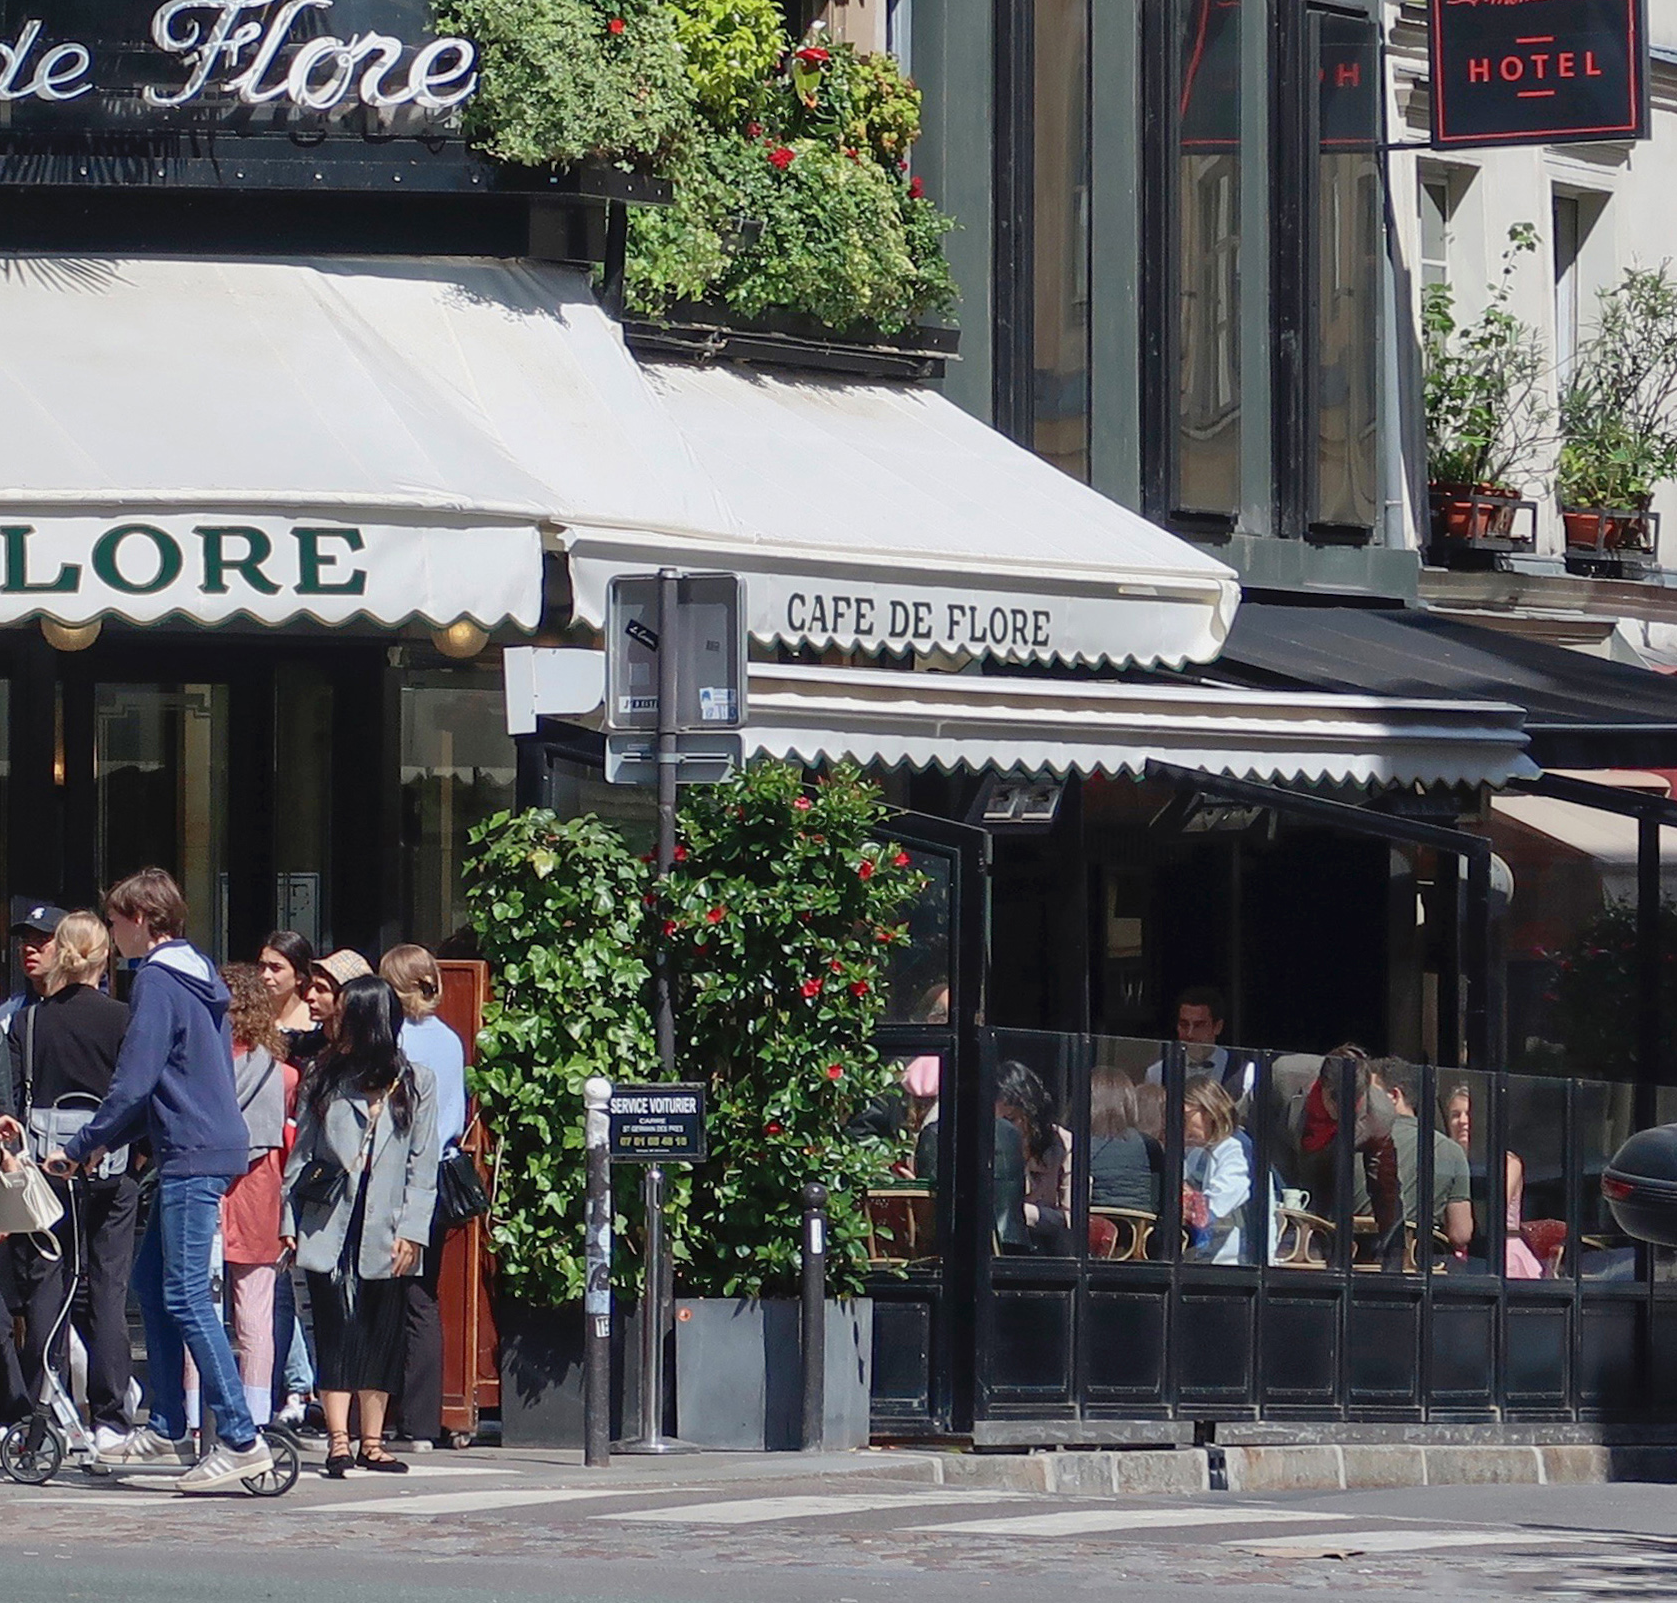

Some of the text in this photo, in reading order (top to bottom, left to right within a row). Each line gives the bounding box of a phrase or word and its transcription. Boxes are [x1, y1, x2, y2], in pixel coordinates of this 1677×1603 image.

[1469, 50, 1602, 83] HOTEL
[787, 592, 1051, 647] CAFE DE FLORE
[610, 1097, 697, 1114] SERVICE VOITURIER
